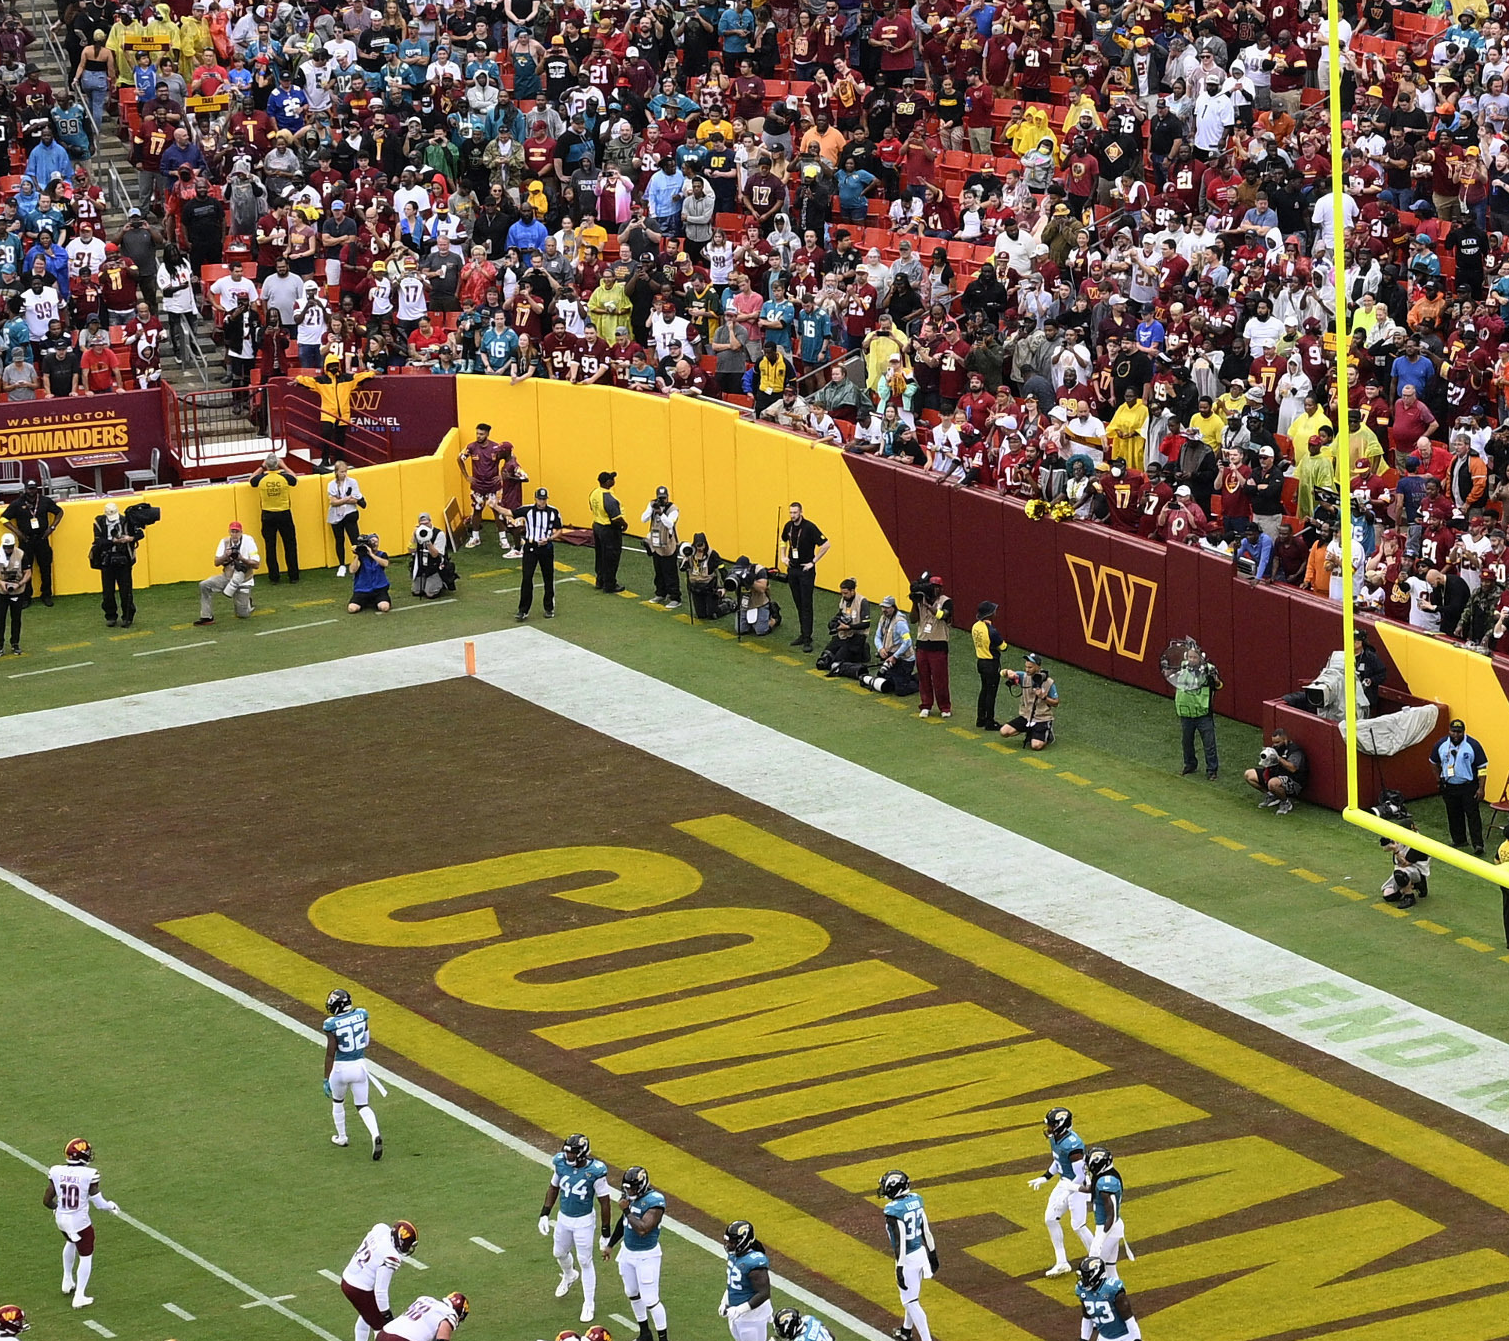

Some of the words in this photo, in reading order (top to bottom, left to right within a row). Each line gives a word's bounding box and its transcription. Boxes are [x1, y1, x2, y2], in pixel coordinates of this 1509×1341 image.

[6, 411, 116, 428] WASHINGTON
[1113, 488, 1130, 507] 17
[1243, 980, 1483, 1069] END
[337, 1024, 368, 1052] 32
[59, 1183, 80, 1210] 10
[560, 1179, 587, 1199] 44
[1082, 1301, 1114, 1324] 23
